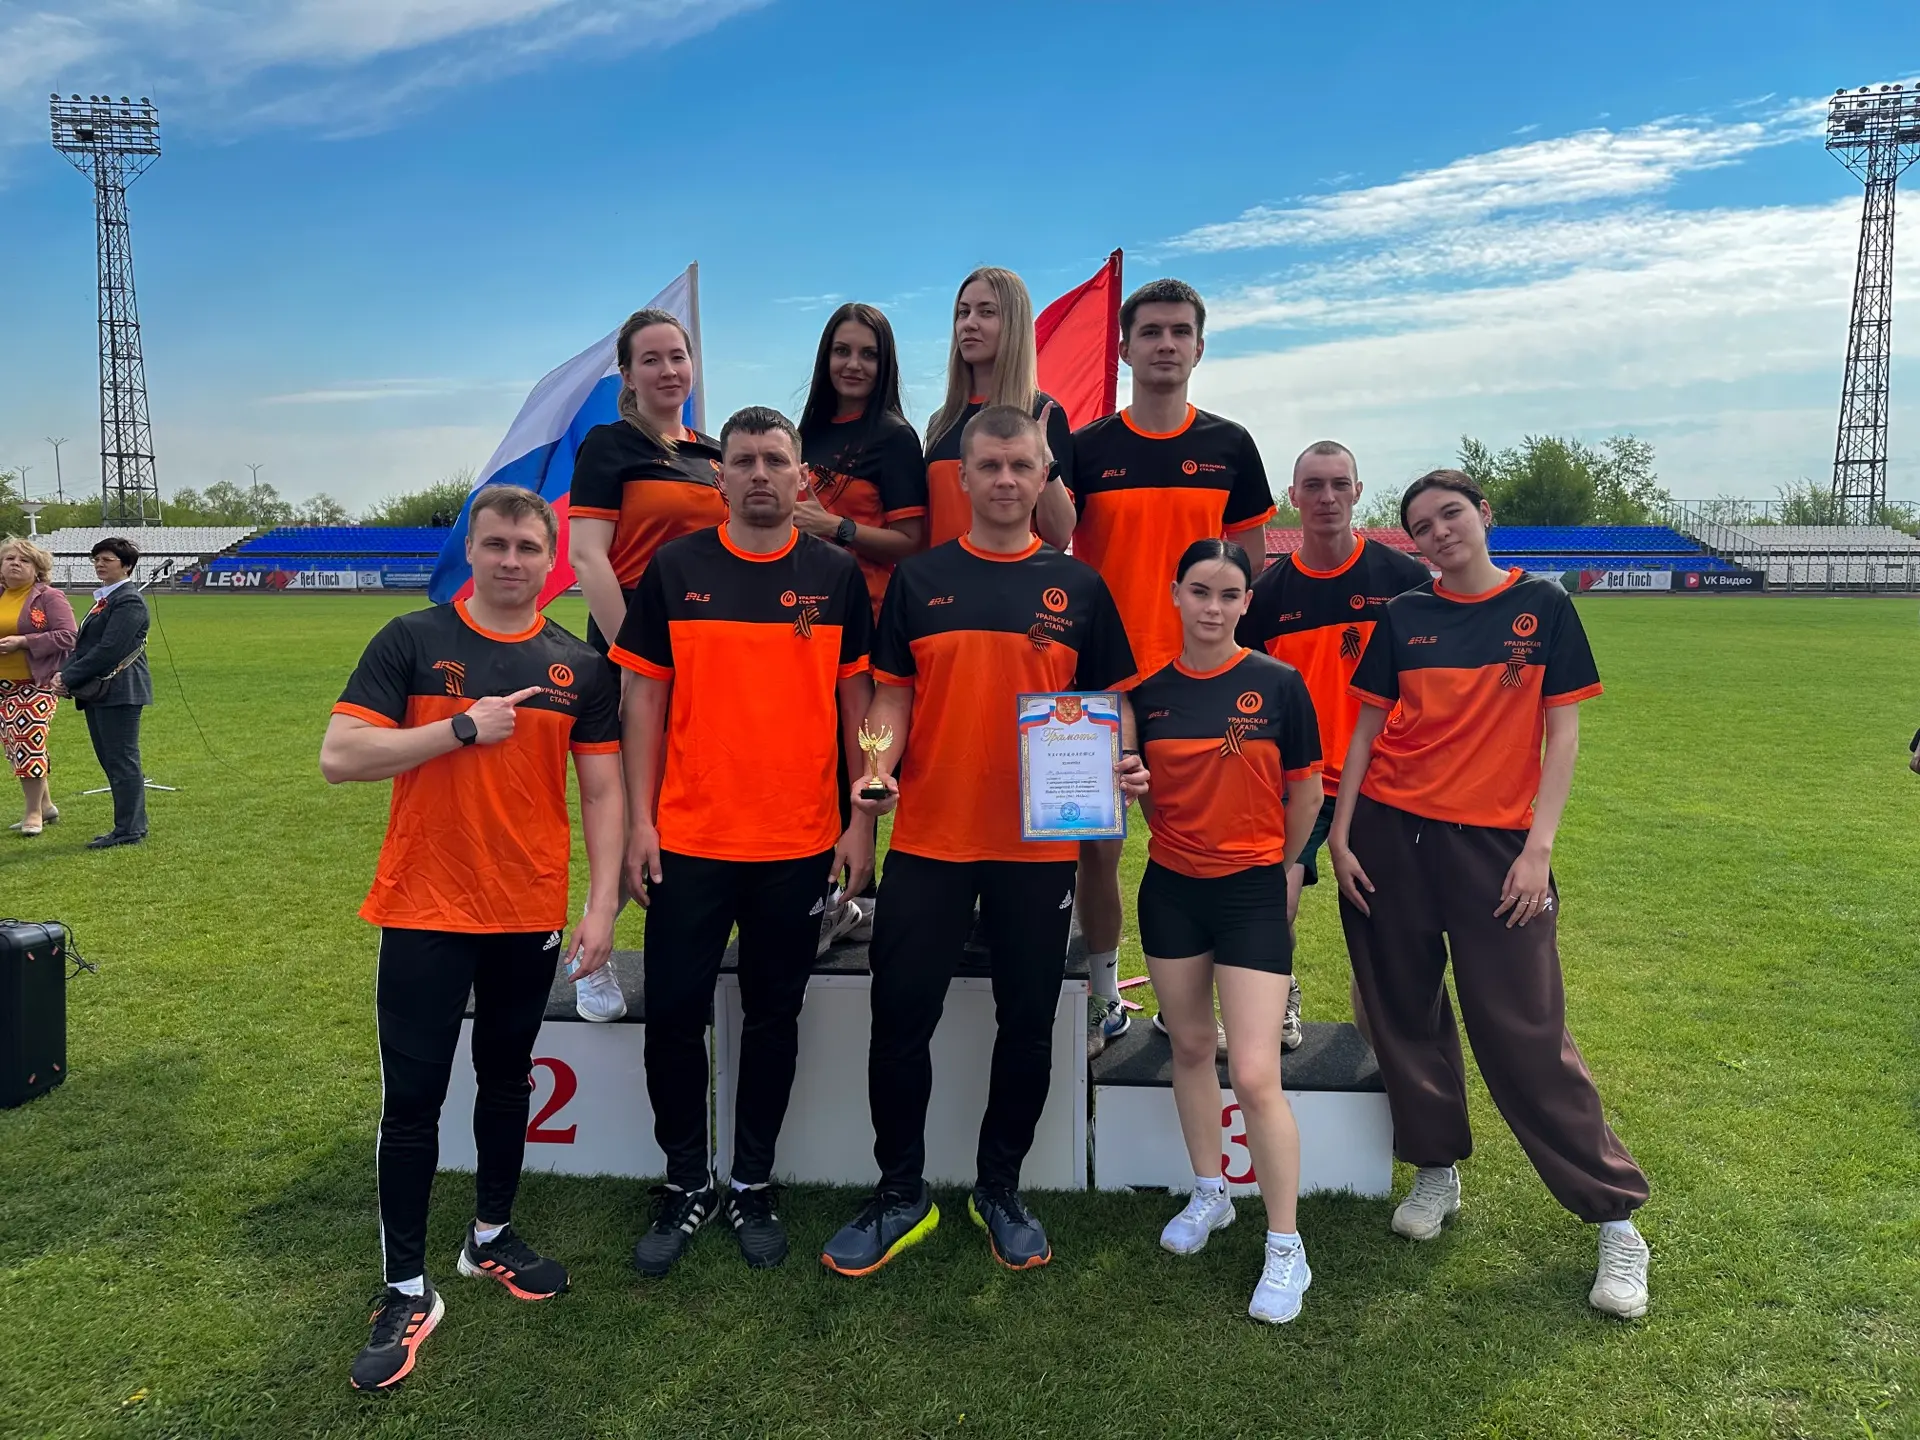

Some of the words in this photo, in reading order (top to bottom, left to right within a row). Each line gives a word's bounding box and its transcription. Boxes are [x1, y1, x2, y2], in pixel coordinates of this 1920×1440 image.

[205, 571, 261, 587] LEON
[300, 572, 317, 586] Red
[318, 572, 340, 586] finch
[1608, 572, 1624, 587] Red
[1627, 572, 1651, 586] finch
[1703, 575, 1718, 585] VK
[1719, 575, 1752, 586] Видео
[1035, 612, 1073, 627] УРАЛЬСКАЯ
[1044, 621, 1065, 632] СТАЛЬ
[540, 687, 578, 701] УРАЛЬСКАЯ
[549, 696, 571, 706] СТАЛЬ
[1227, 716, 1268, 725] УРАЛЬСКАЯ
[1040, 727, 1098, 746] Грамота
[526, 1057, 577, 1144] 2
